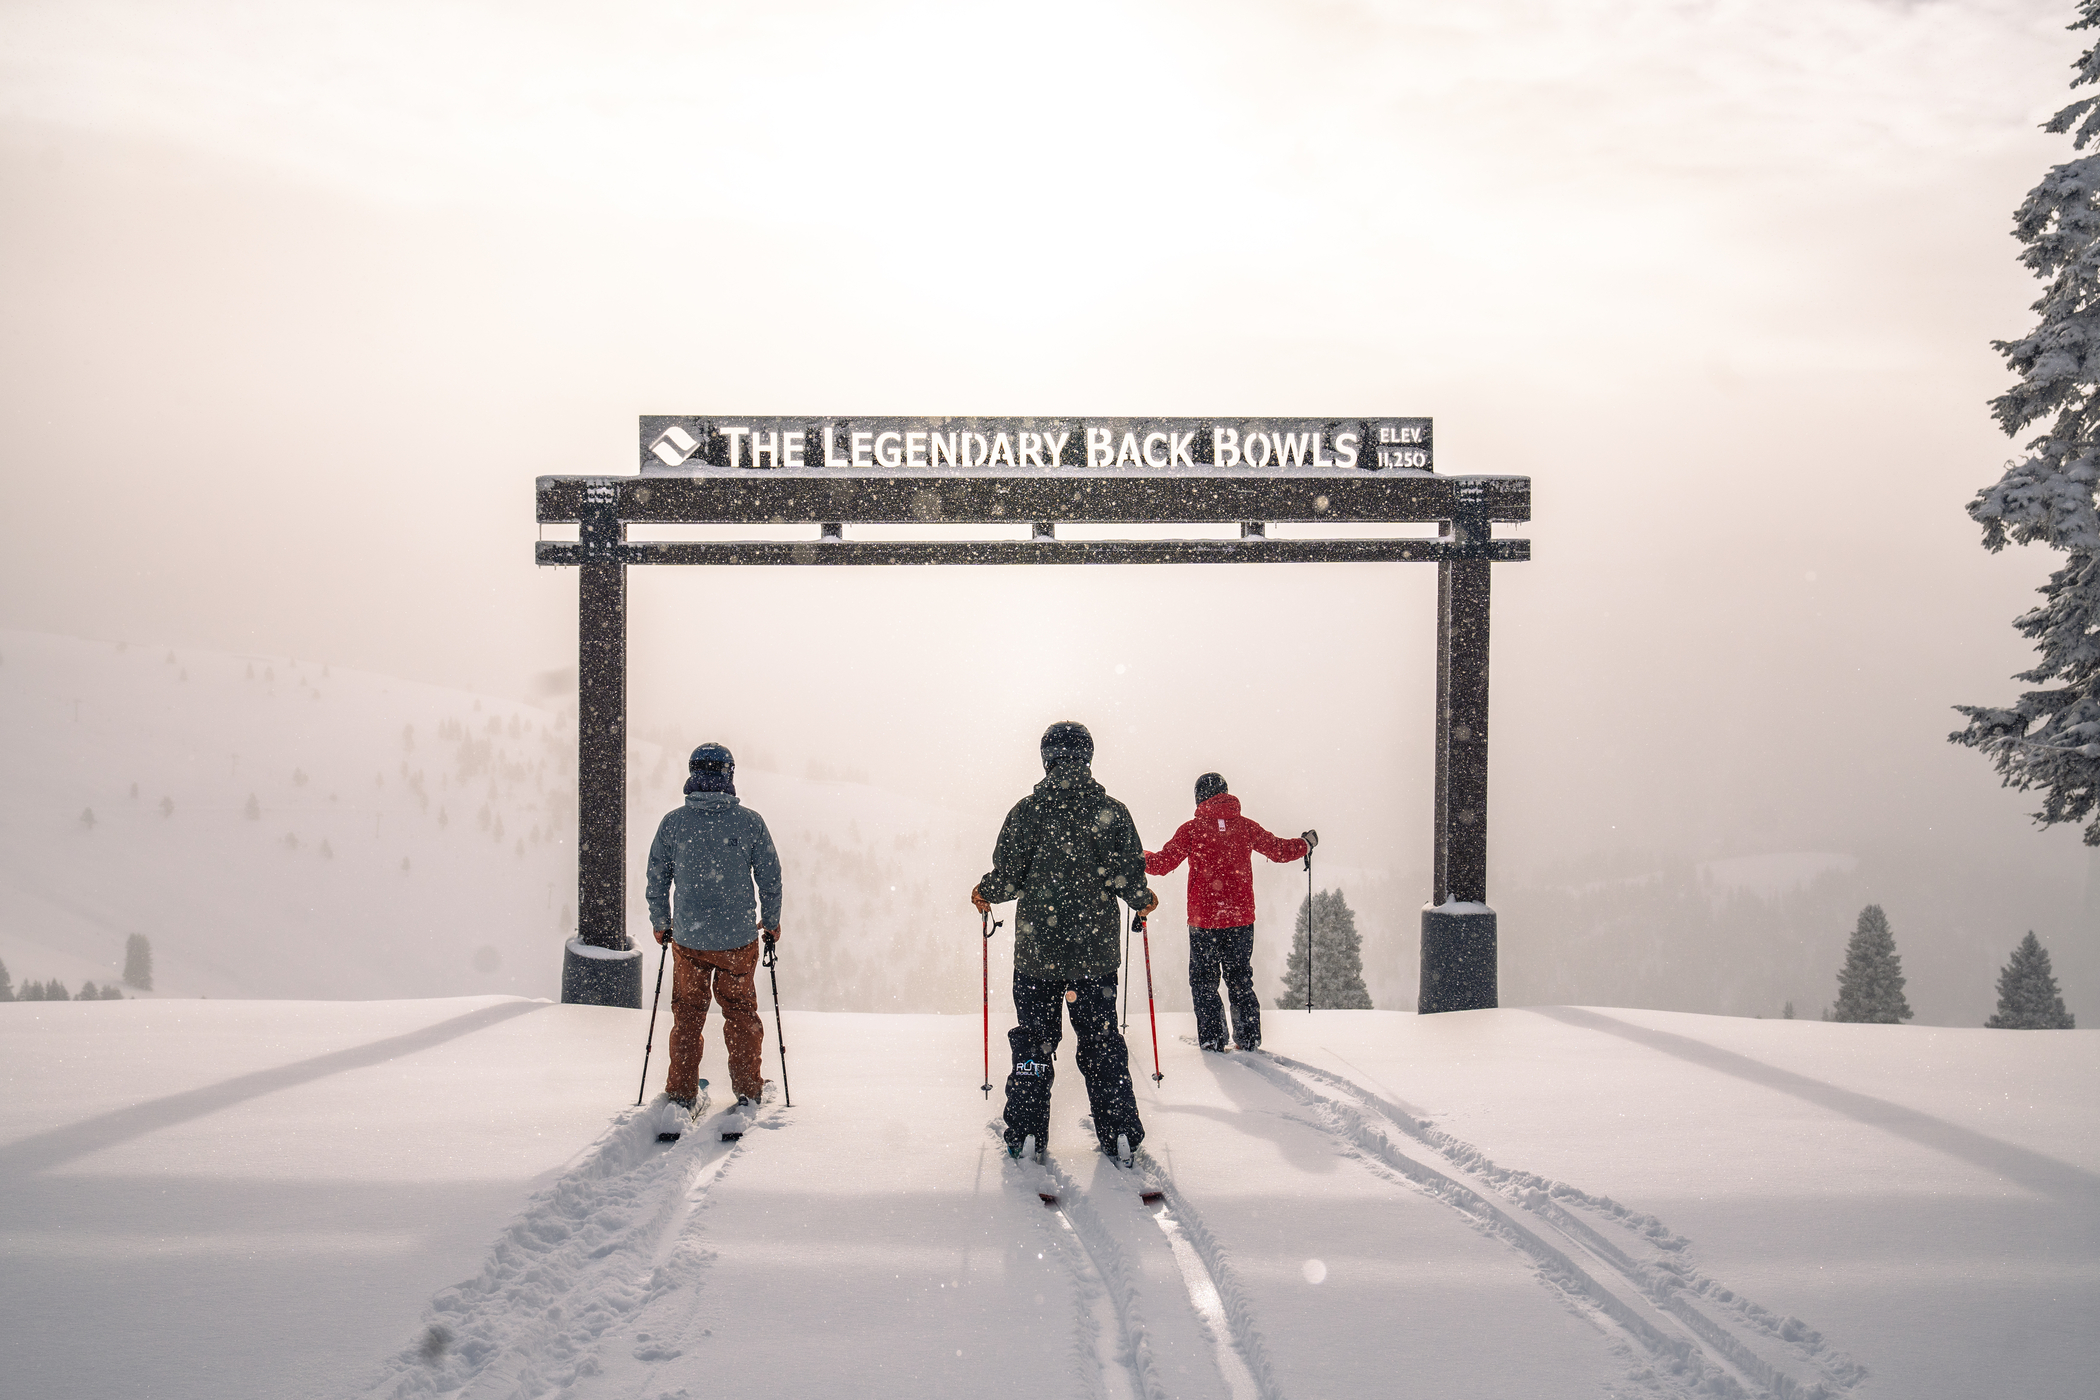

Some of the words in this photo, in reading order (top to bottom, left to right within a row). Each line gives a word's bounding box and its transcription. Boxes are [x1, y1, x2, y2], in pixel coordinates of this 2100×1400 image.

[1380, 427, 1422, 443] ELEV.
[719, 427, 804, 467] THE
[823, 427, 1068, 467] LEGENDARY
[1086, 427, 1195, 467] BACK
[1213, 427, 1358, 468] BOWLS
[1378, 452, 1425, 469] 11,250
